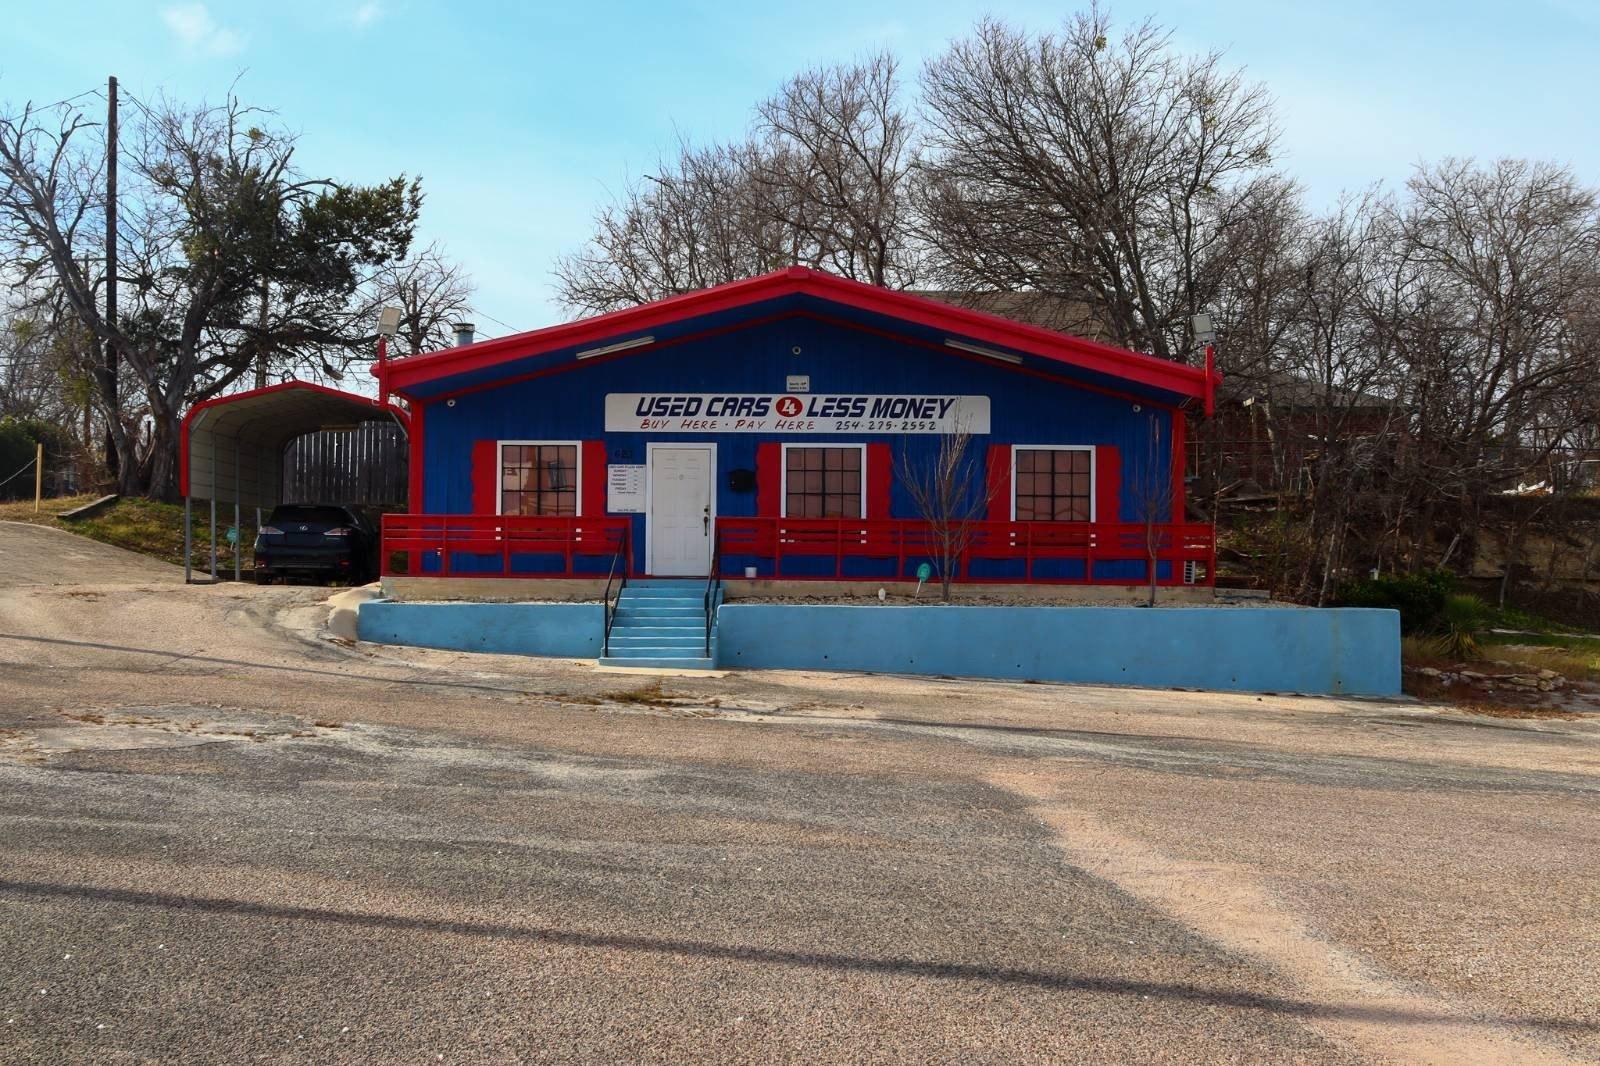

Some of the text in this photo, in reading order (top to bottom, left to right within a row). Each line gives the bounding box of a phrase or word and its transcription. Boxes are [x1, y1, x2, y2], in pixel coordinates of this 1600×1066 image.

[635, 396, 955, 419] USED CARS 4 LESS MONEY
[640, 418, 815, 431] BUY HERE PAY HERE
